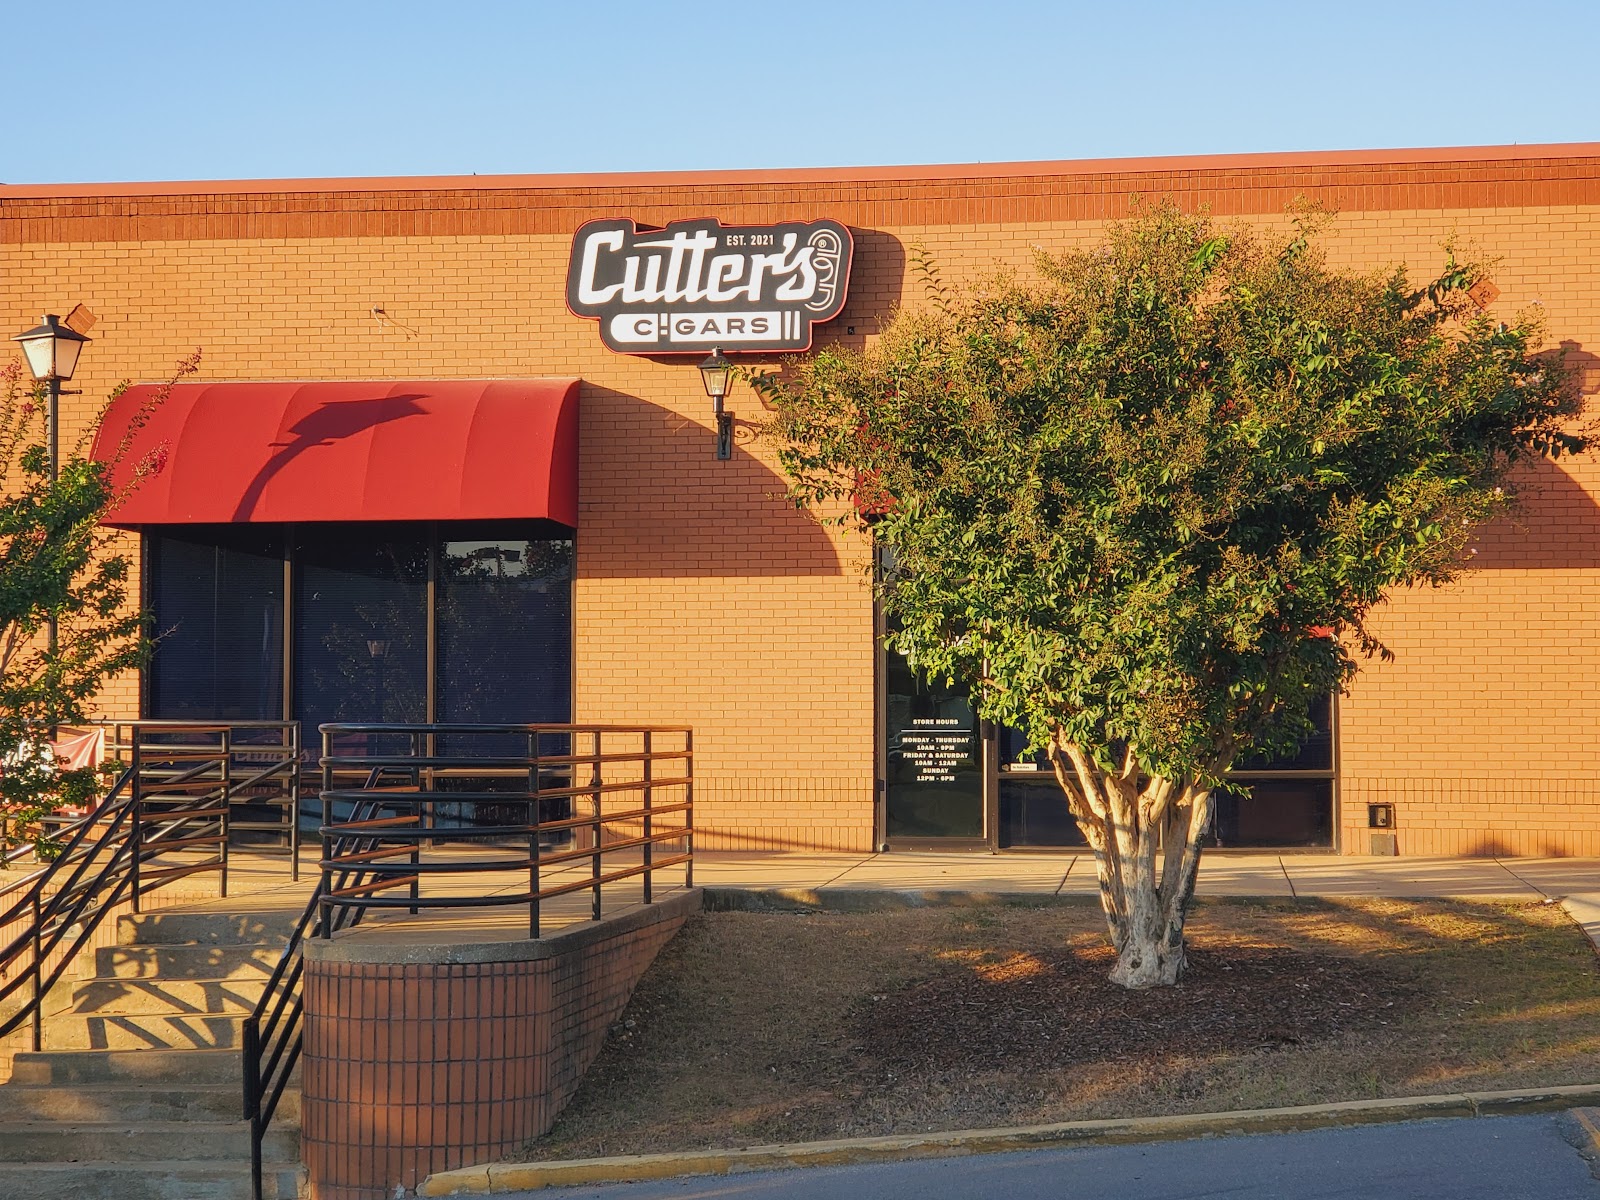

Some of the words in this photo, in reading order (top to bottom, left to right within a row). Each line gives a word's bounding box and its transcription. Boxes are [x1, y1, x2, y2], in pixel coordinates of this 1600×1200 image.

[726, 234, 747, 246] EST.
[750, 234, 774, 246] 2021
[578, 230, 817, 304] Cutter's
